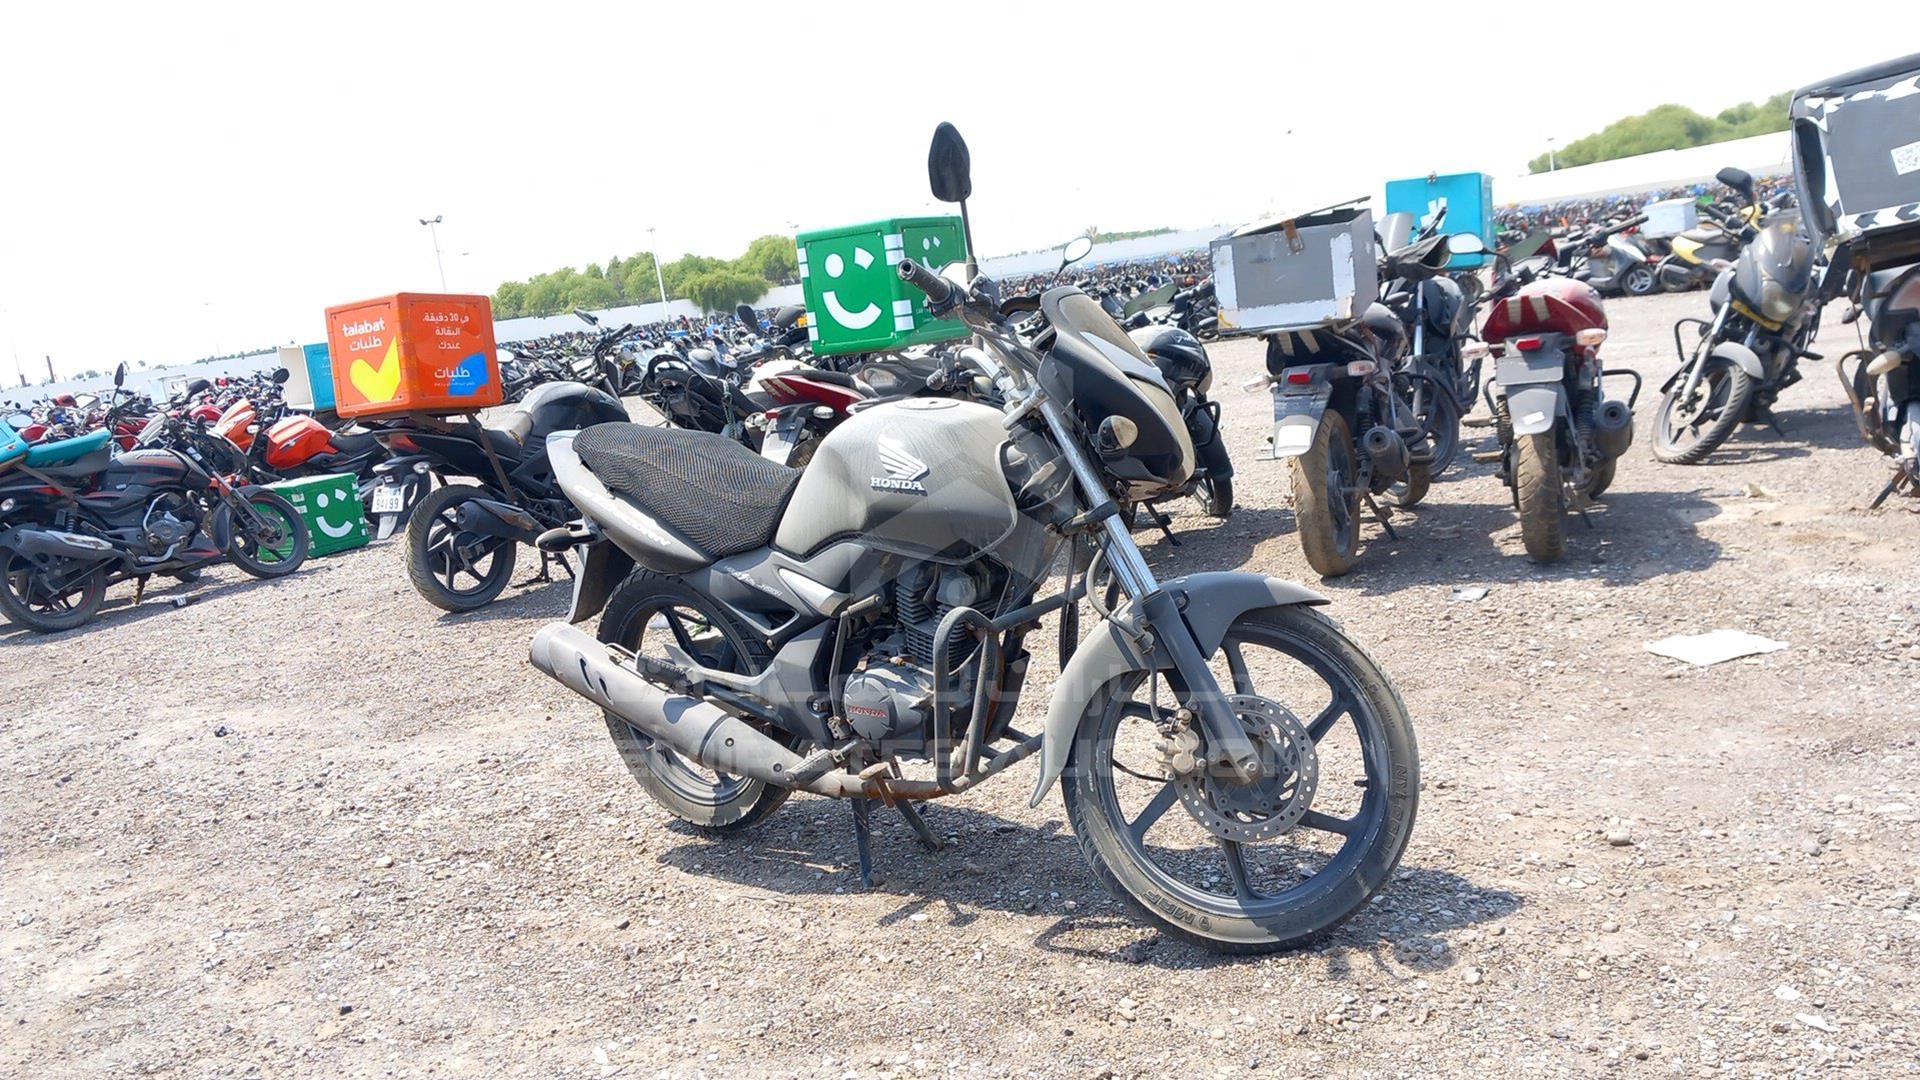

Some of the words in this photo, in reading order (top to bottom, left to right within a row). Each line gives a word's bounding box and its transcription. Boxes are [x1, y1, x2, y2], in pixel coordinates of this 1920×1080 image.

[449, 312, 459, 322] 30
[342, 317, 385, 337] talabat
[349, 336, 383, 353] طلبات
[434, 366, 471, 382] طلبات
[870, 476, 926, 493] HONDA
[848, 704, 888, 718] HONDA
[1143, 889, 1196, 925] MRF
